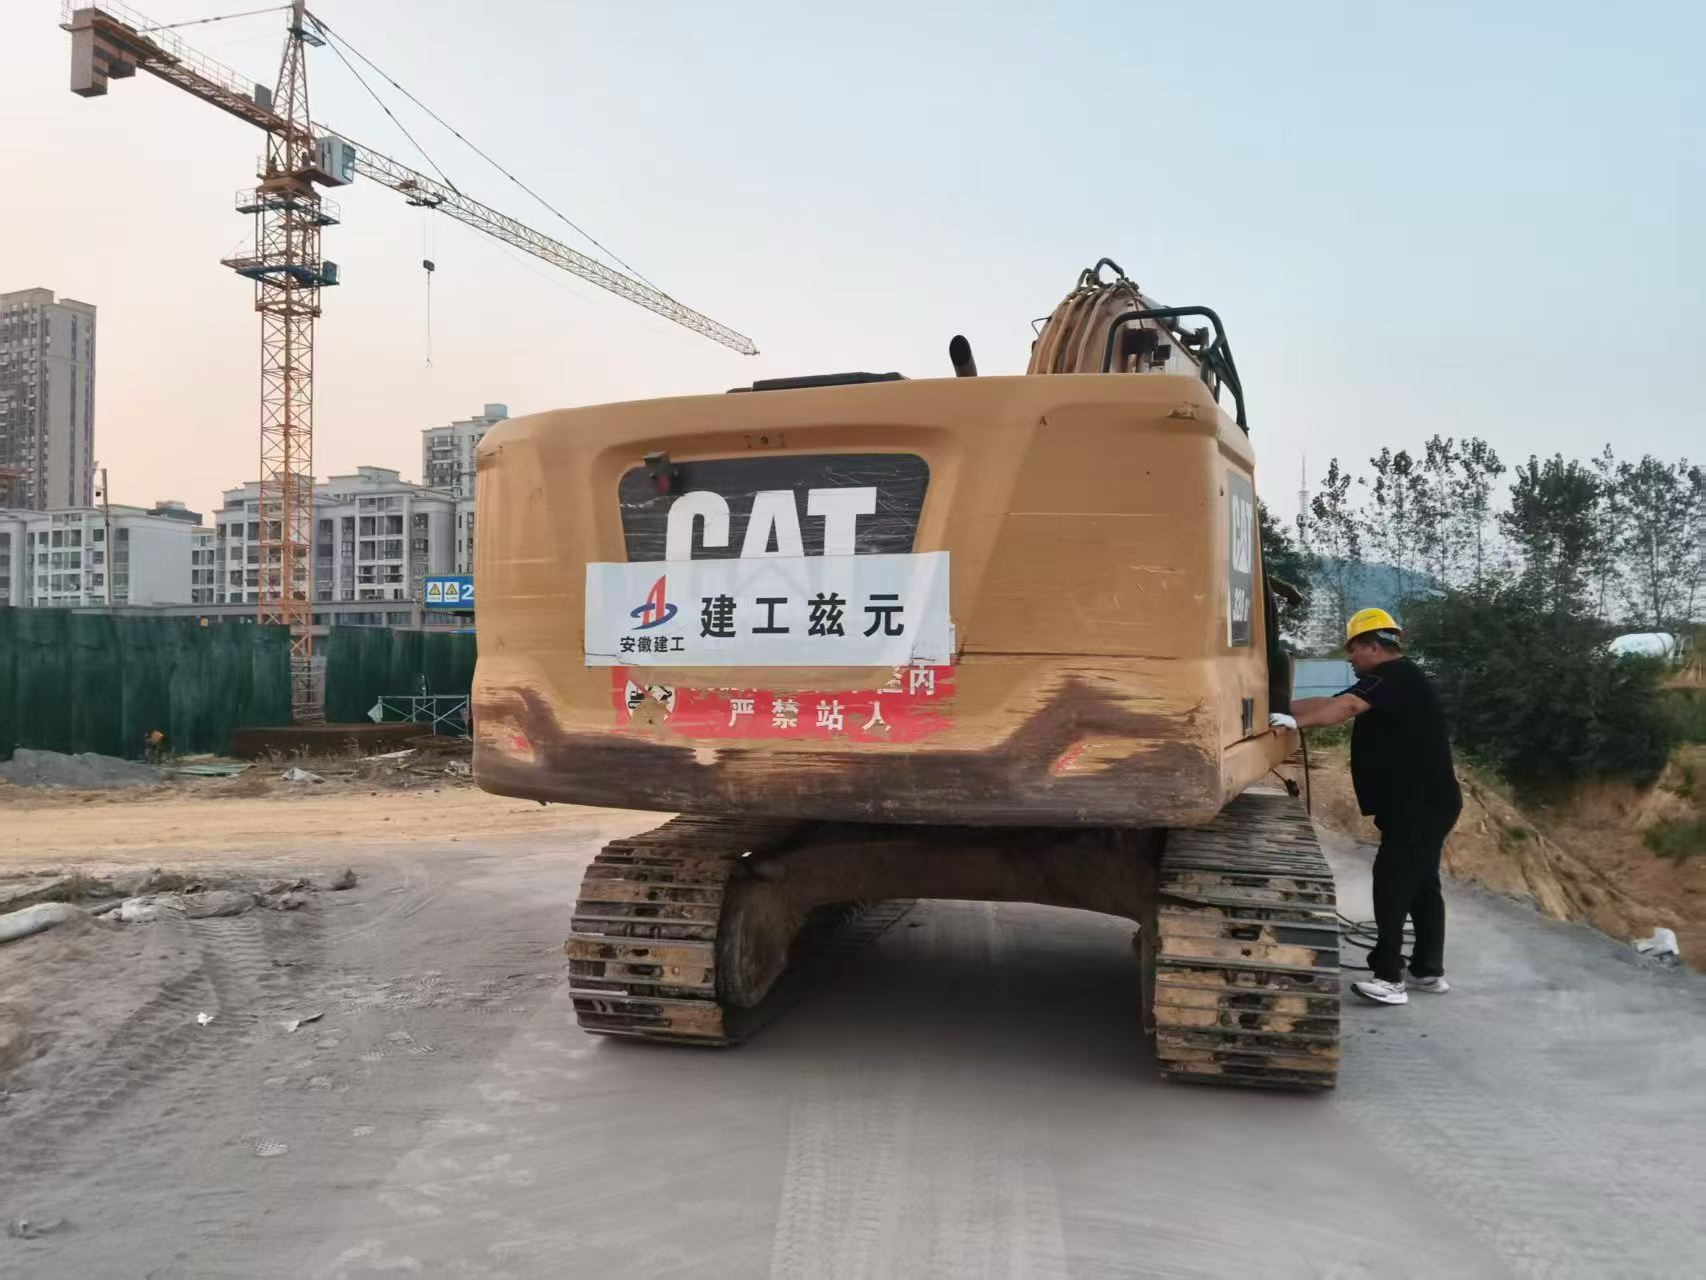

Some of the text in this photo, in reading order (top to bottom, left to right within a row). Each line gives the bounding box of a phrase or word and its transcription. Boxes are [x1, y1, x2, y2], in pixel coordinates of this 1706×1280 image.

[665, 487, 877, 562] CAT
[1232, 494, 1252, 574] CAT
[700, 593, 905, 638] 建工兹元
[619, 635, 685, 653] 安徽建工
[728, 698, 891, 731] 严禁站人
